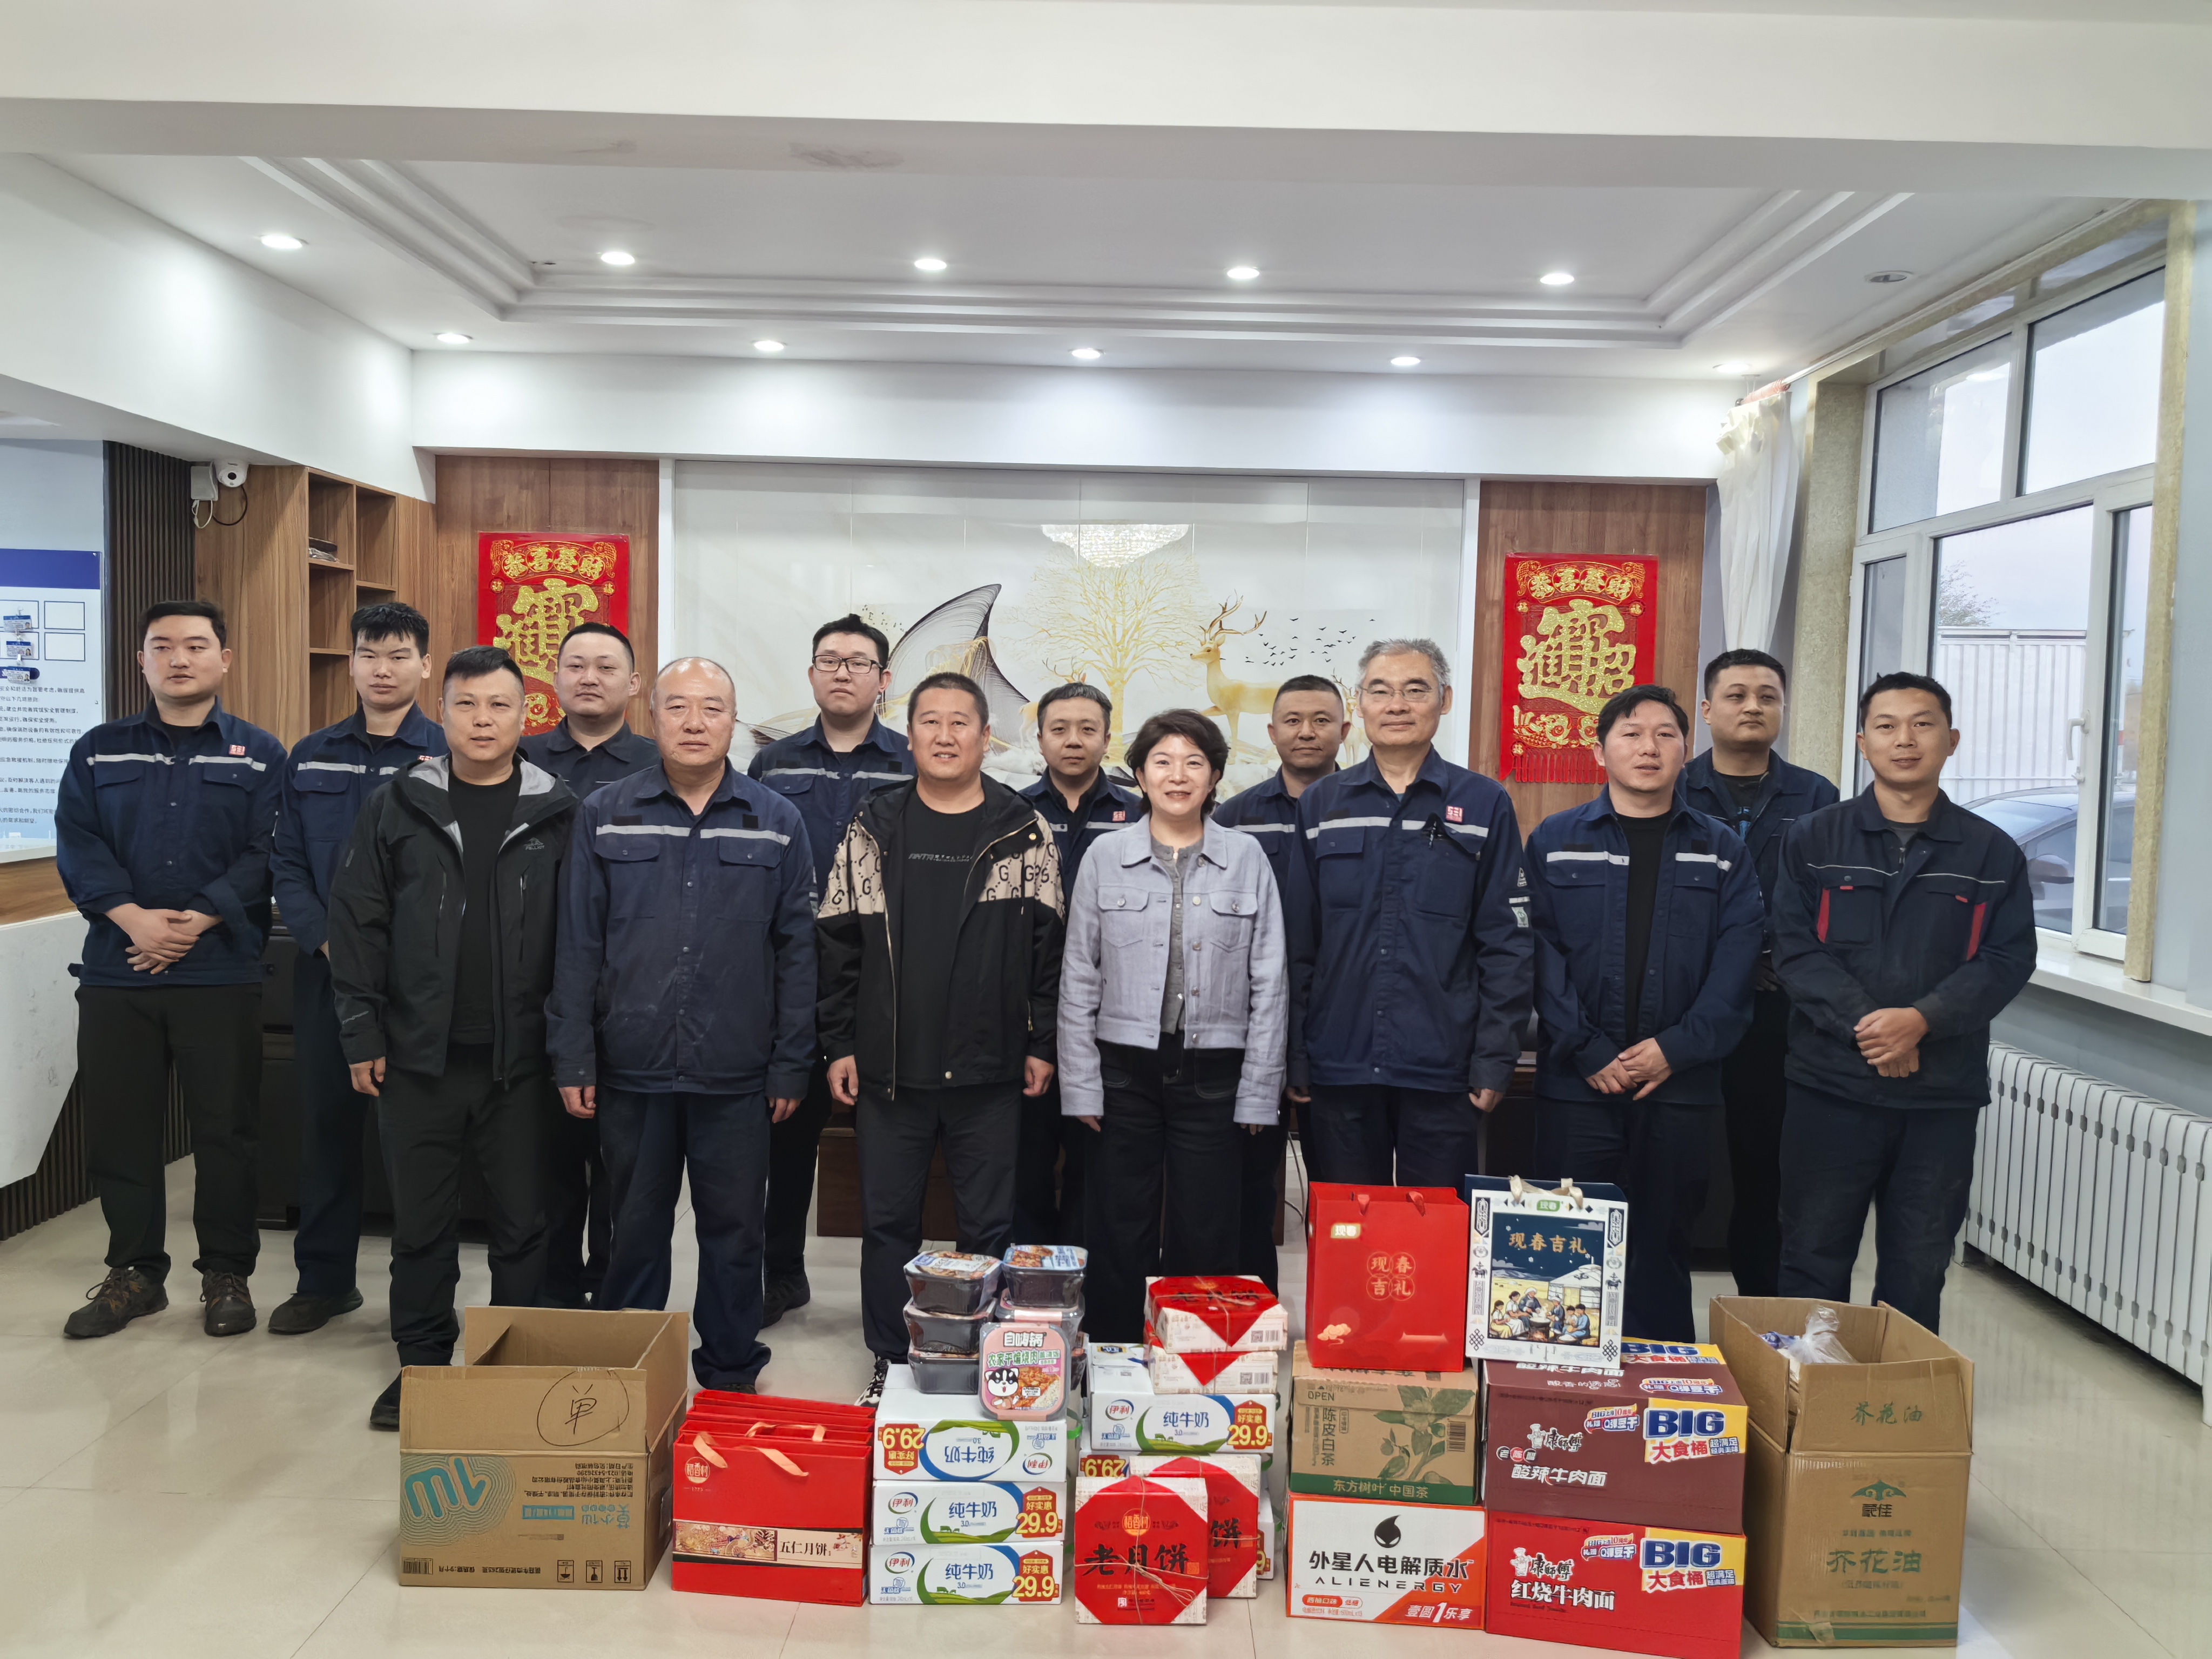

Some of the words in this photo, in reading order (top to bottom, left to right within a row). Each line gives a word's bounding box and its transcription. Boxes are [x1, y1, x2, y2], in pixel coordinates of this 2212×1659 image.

[1508, 1232, 1587, 1254] 现春吉礼
[1371, 1256, 1412, 1273] 现春
[1371, 1278, 1411, 1296] 吉礼
[1308, 1391, 1334, 1401] OPEN
[1110, 1405, 1129, 1414] 伊利
[1163, 1411, 1210, 1428] 纯牛奶
[1851, 1401, 1923, 1425] 芥花油
[1647, 1410, 1725, 1439] BIG
[882, 1427, 925, 1449] 29.9
[1227, 1425, 1268, 1446] 29.9
[1321, 1407, 1337, 1466] 陈皮白茶
[945, 1446, 994, 1464] 纯牛奶
[1653, 1440, 1708, 1461] 大食桶
[1027, 1459, 1049, 1469] 伊利
[1085, 1459, 1125, 1478] 29.9
[1510, 1464, 1608, 1487] 酸辣牛肉面
[1333, 1480, 1385, 1495] 东方树叶
[1389, 1485, 1428, 1499] 中国茶
[892, 1498, 914, 1507] 伊利
[948, 1501, 997, 1519] 纯牛奶
[1016, 1512, 1058, 1534] 29.9
[779, 1541, 828, 1556] 五仁月饼
[1643, 1540, 1721, 1568] BIG
[889, 1557, 911, 1567] 伊利
[1082, 1543, 1191, 1576] 老月饼
[1309, 1550, 1468, 1580] 外星人电解质水
[1530, 1553, 1573, 1580] 康師傅
[1826, 1548, 1922, 1574] 芥花油
[945, 1563, 993, 1580] 纯牛奶
[1648, 1570, 1704, 1590] 大食桶
[1012, 1576, 1054, 1599] 29.9
[1316, 1576, 1462, 1593] ALIENERGY
[1510, 1579, 1615, 1610] 红烧牛肉面
[1405, 1602, 1473, 1623] 壹圆1乐享
